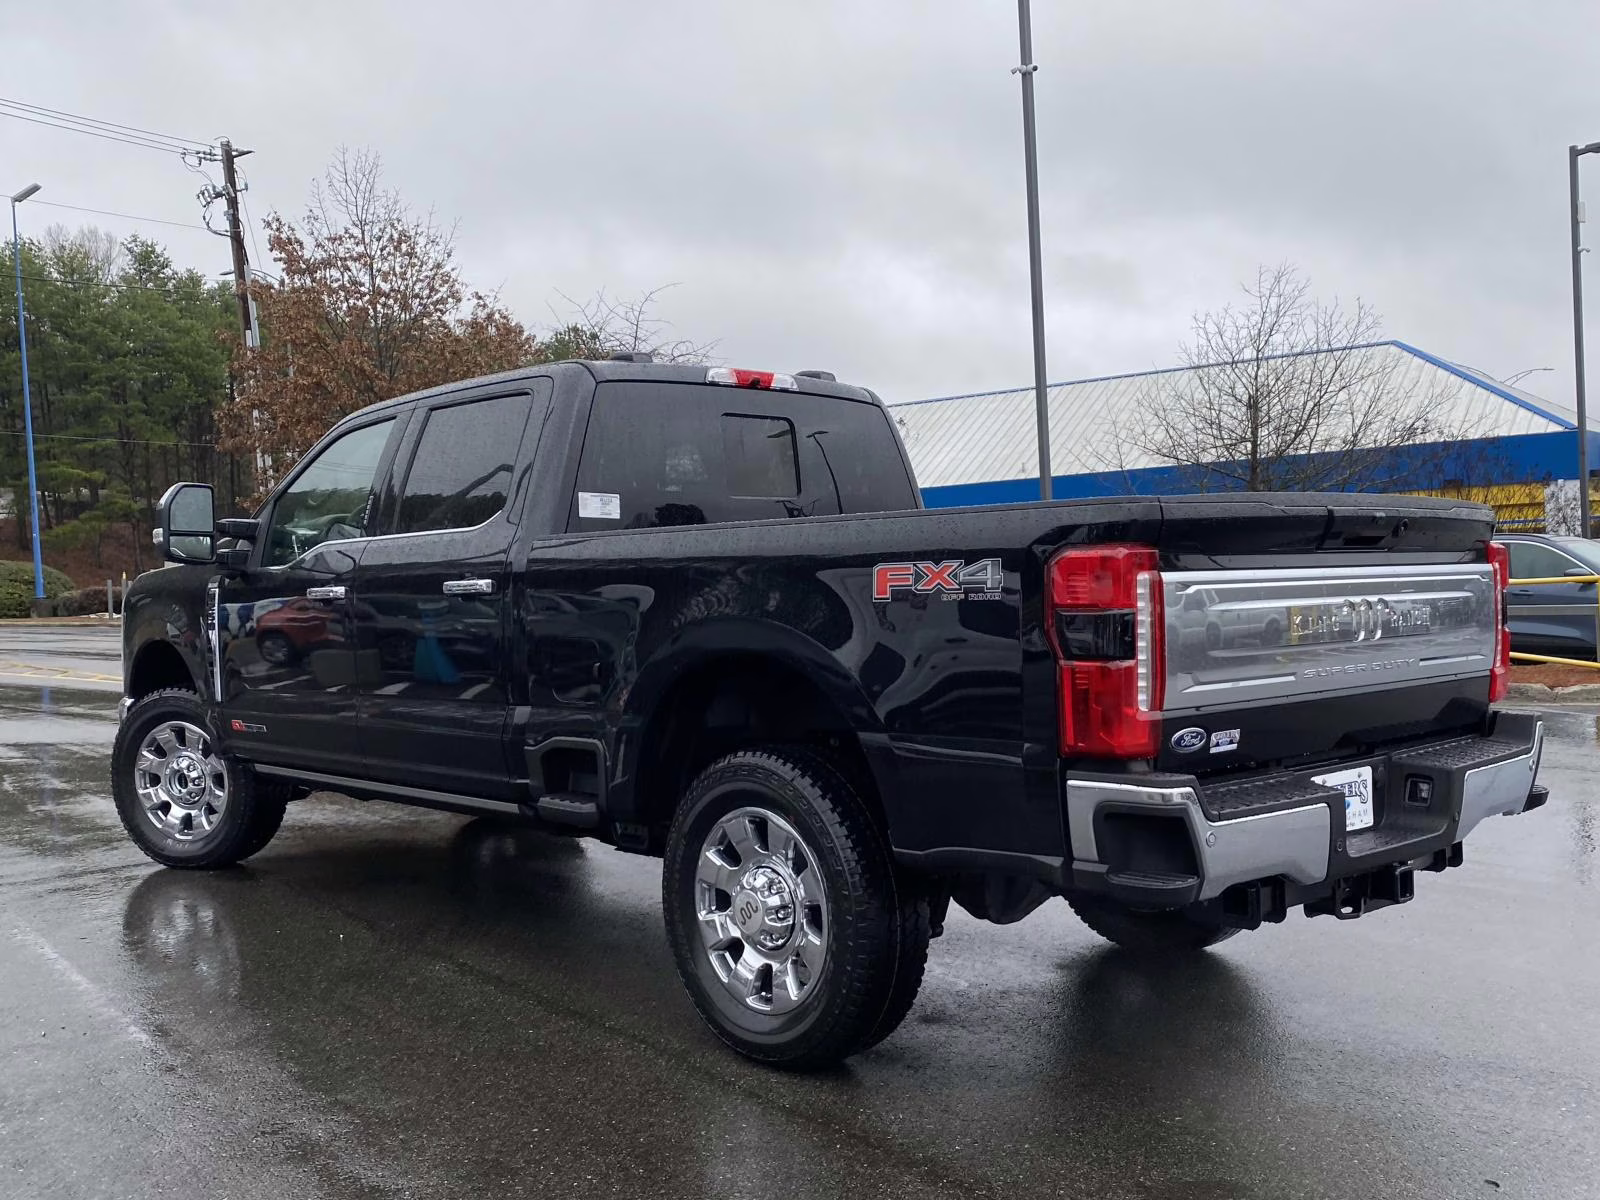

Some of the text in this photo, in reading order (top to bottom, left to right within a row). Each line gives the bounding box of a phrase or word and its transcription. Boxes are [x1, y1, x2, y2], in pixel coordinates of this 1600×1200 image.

[873, 558, 1003, 602] FX4
[1292, 615, 1340, 635] KING
[1303, 658, 1416, 678] SUPER DUTY
